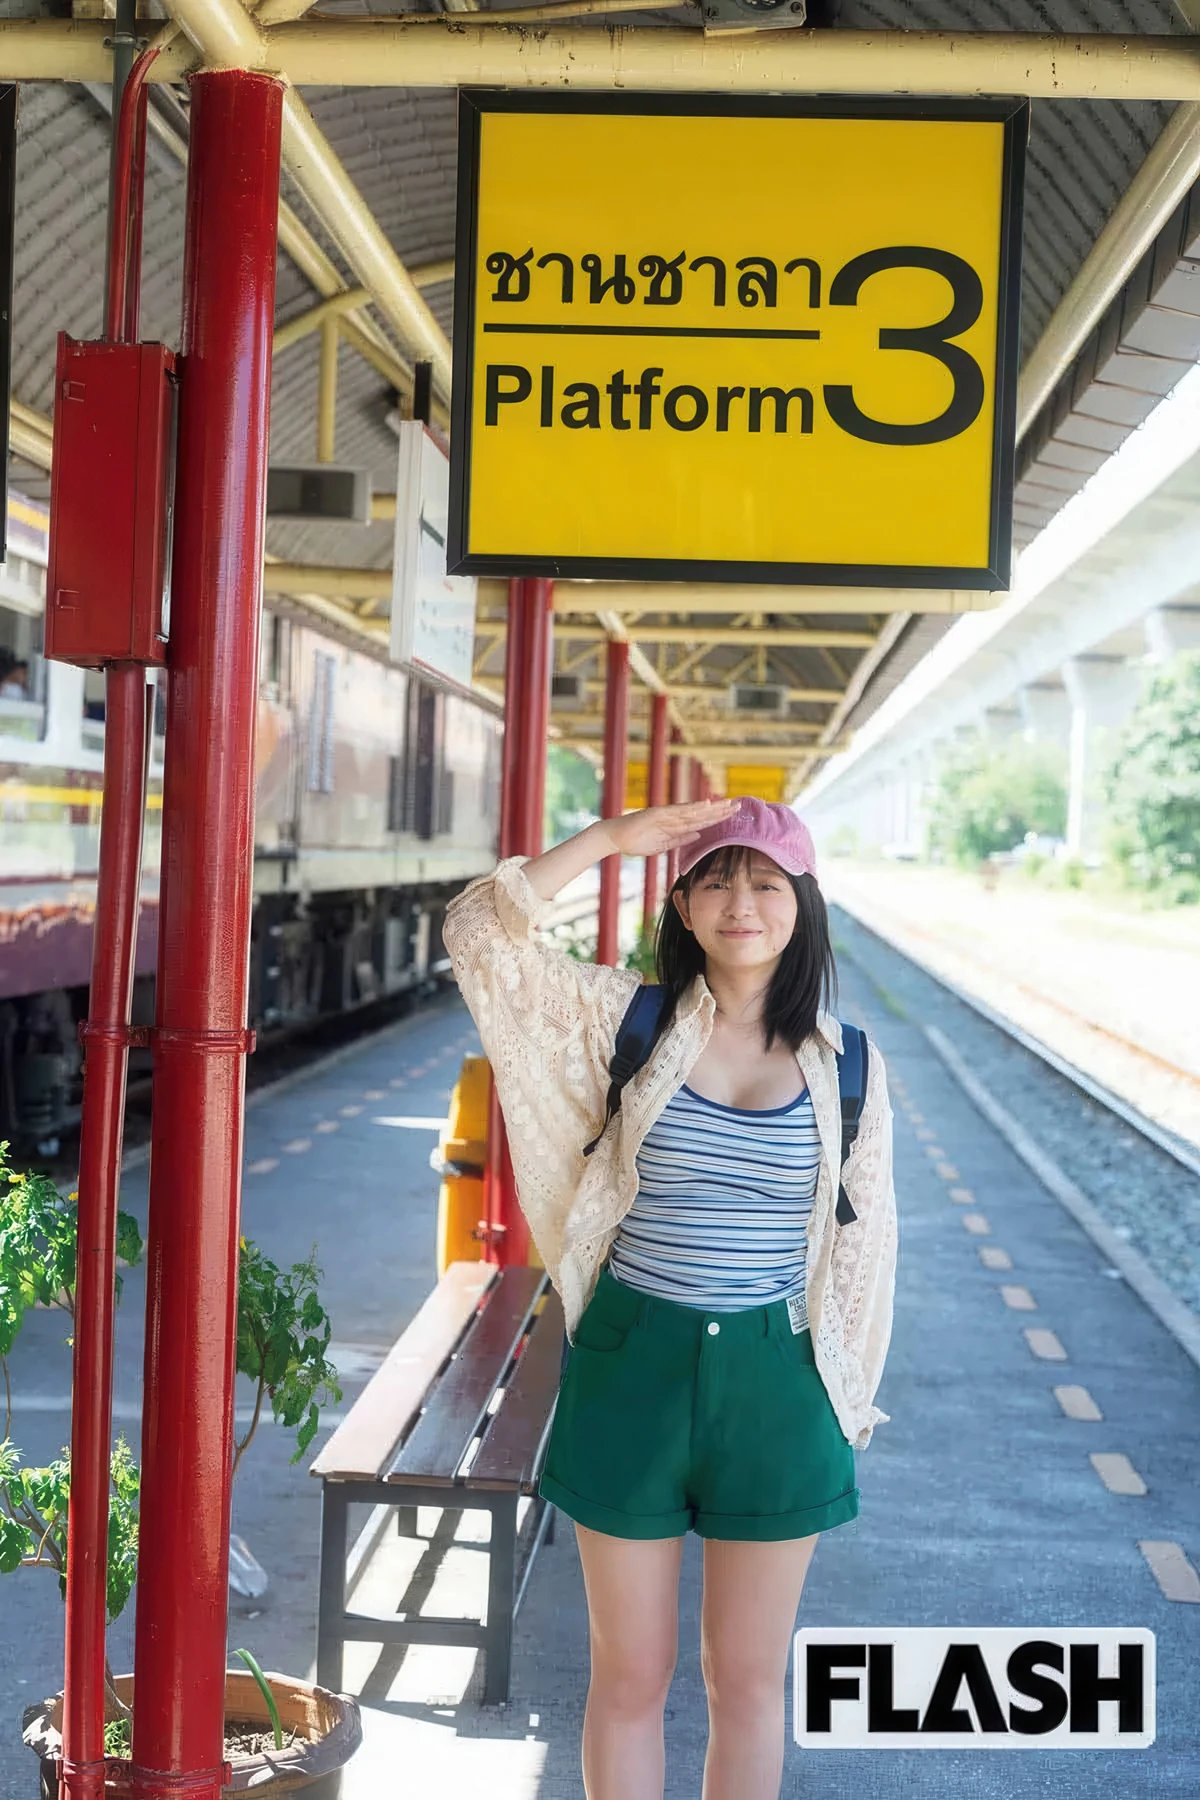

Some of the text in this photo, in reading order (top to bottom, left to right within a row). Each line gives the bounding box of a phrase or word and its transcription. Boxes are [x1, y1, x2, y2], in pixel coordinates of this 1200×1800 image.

[485, 247, 821, 309] ชานชาลา
[823, 245, 985, 446] 3
[484, 364, 814, 434] Platform
